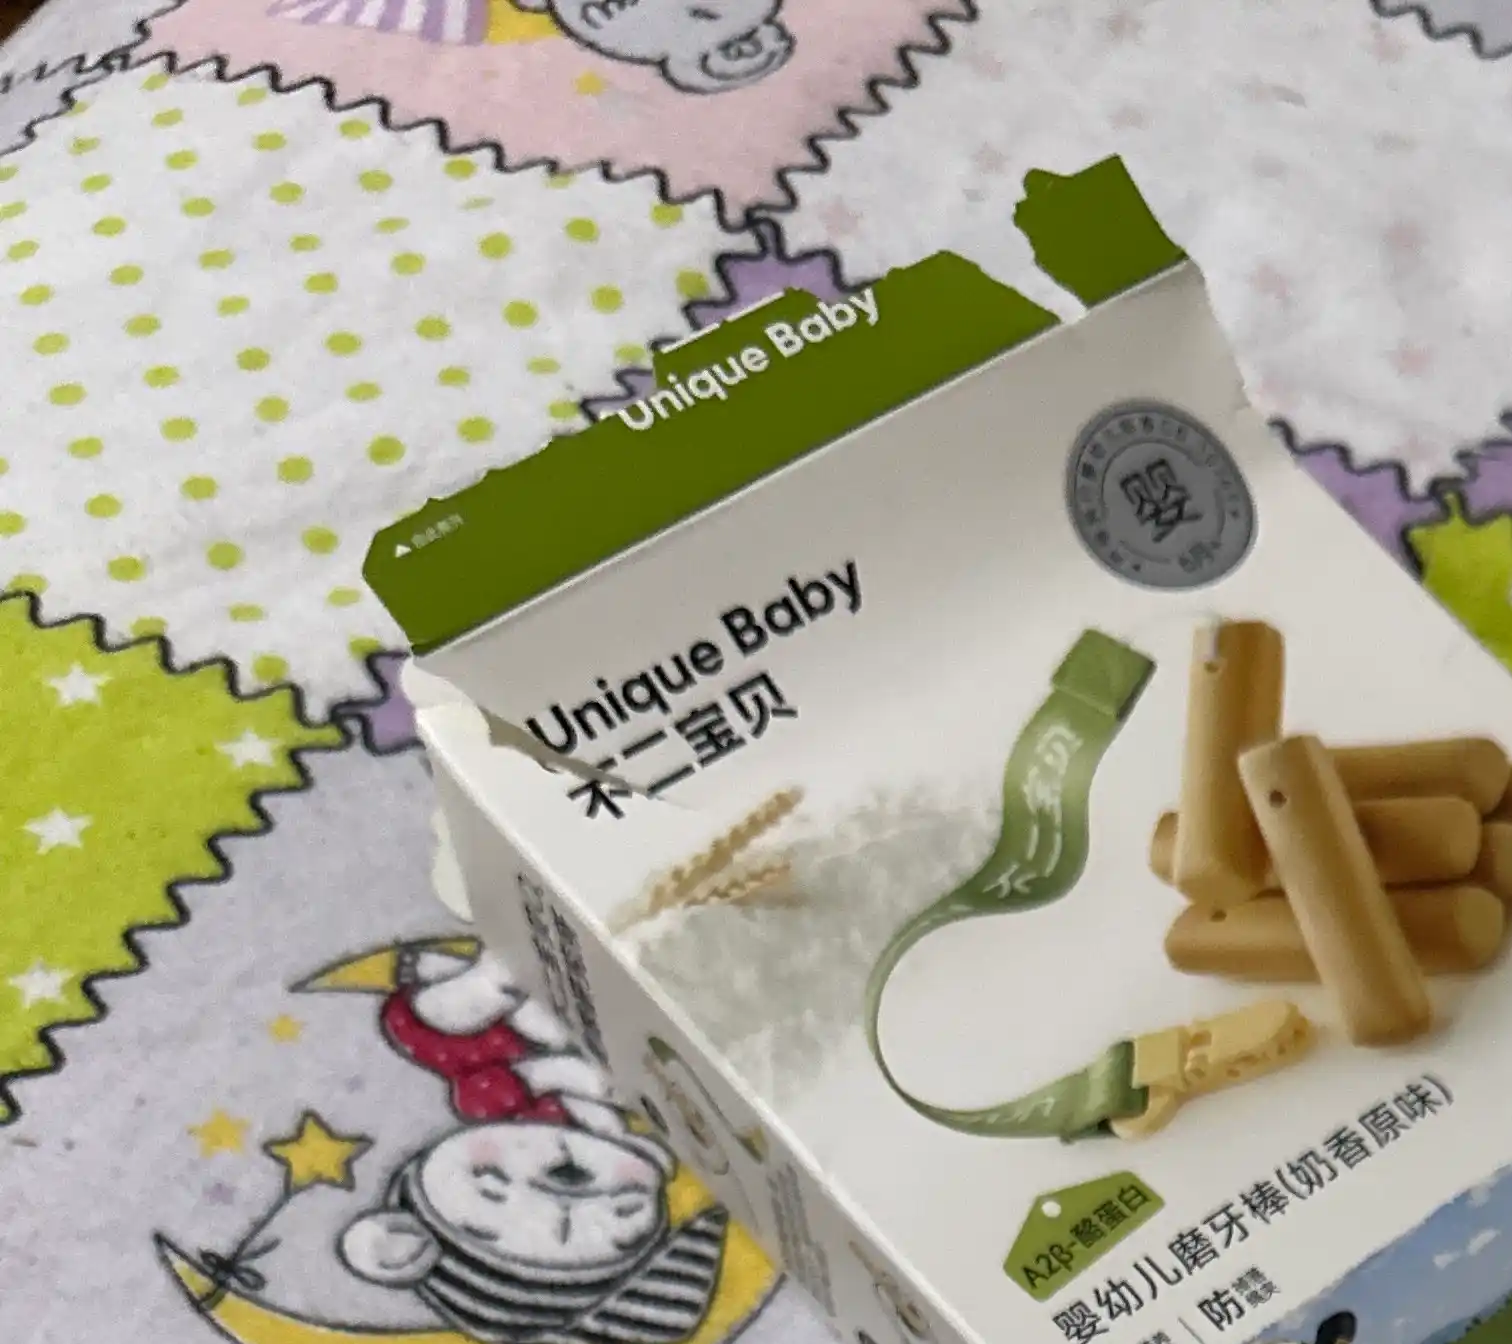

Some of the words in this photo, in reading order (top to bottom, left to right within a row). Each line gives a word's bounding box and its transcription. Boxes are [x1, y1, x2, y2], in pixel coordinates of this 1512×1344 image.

[617, 345, 770, 431] Unique
[765, 287, 880, 358] Baby
[1119, 457, 1204, 543] 婴
[525, 639, 725, 755] Unique
[719, 558, 864, 658] Baby
[567, 671, 800, 820] 不二宝贝
[1196, 1288, 1246, 1332] 防
